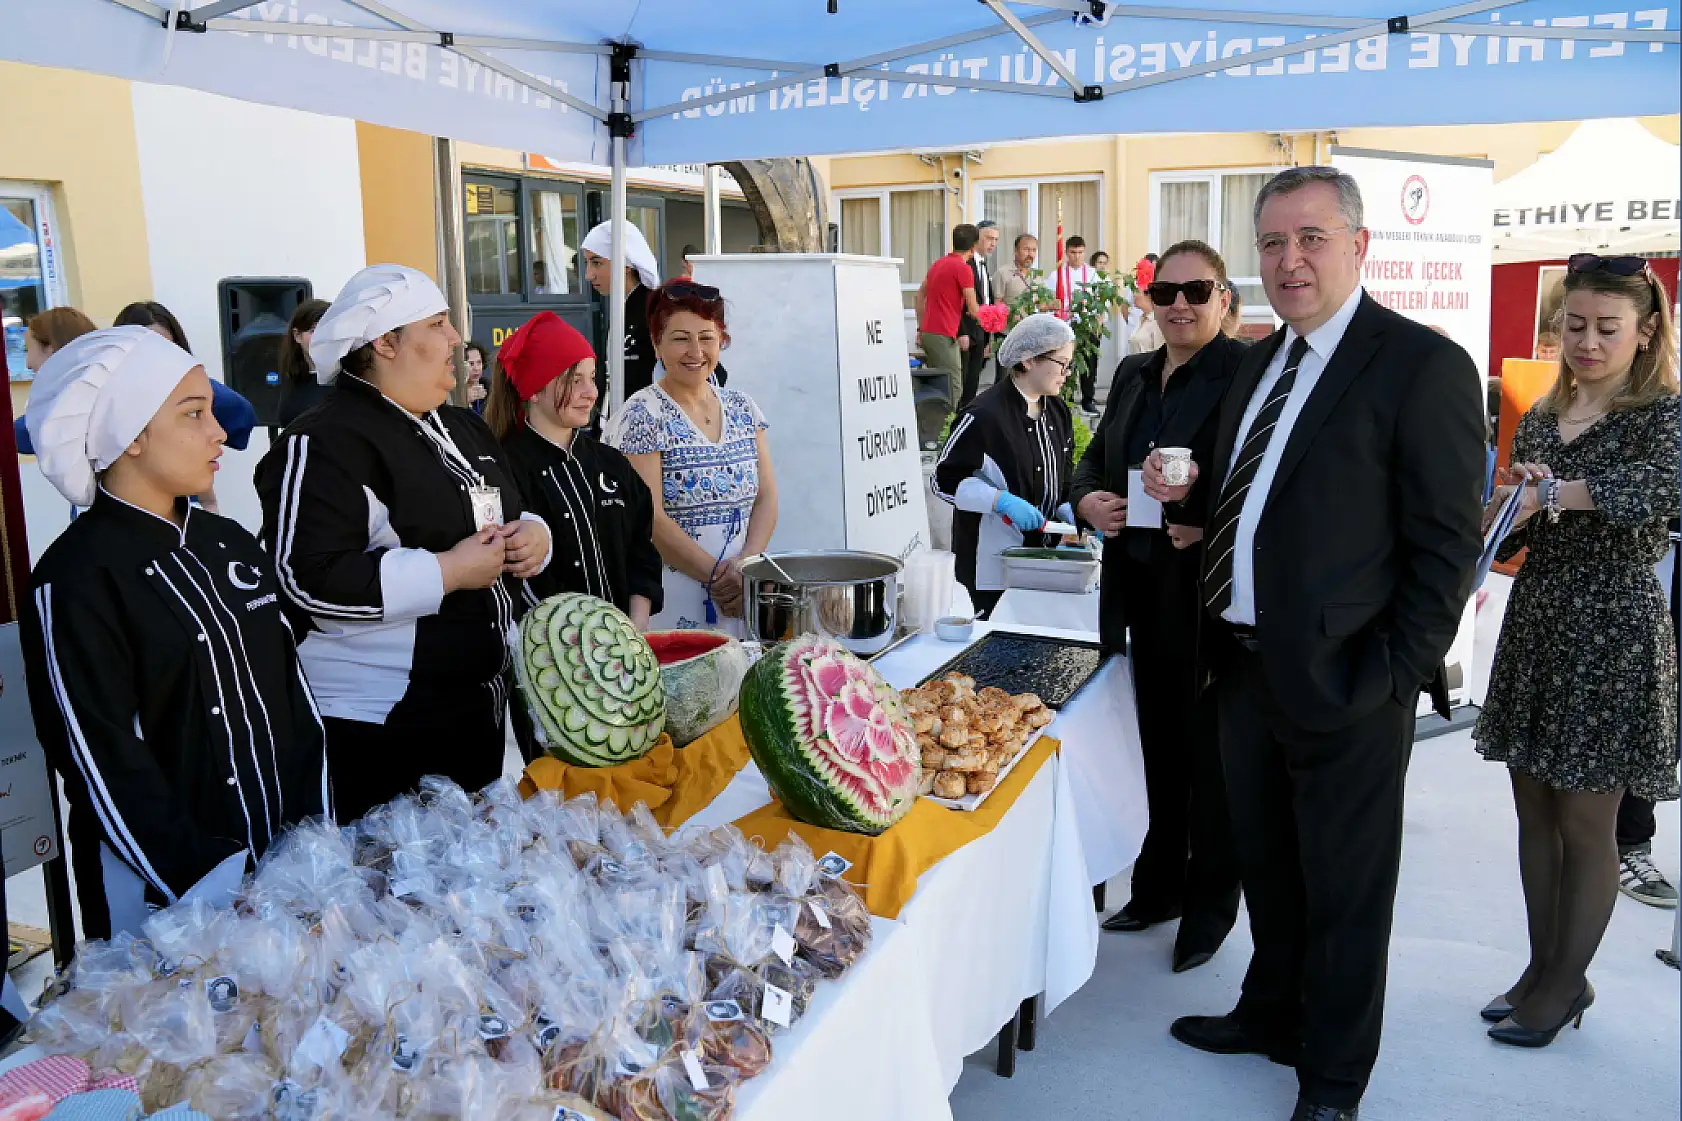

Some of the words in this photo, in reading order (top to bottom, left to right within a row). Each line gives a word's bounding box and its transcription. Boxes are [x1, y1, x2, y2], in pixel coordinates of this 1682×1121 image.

[1363, 255, 1413, 280] YİYECEK
[1431, 291, 1469, 310] ALANI
[865, 319, 883, 345] NE
[857, 374, 898, 402] MUTLU
[857, 424, 907, 461] TÜRKÜM
[866, 481, 908, 517] DİYENE
